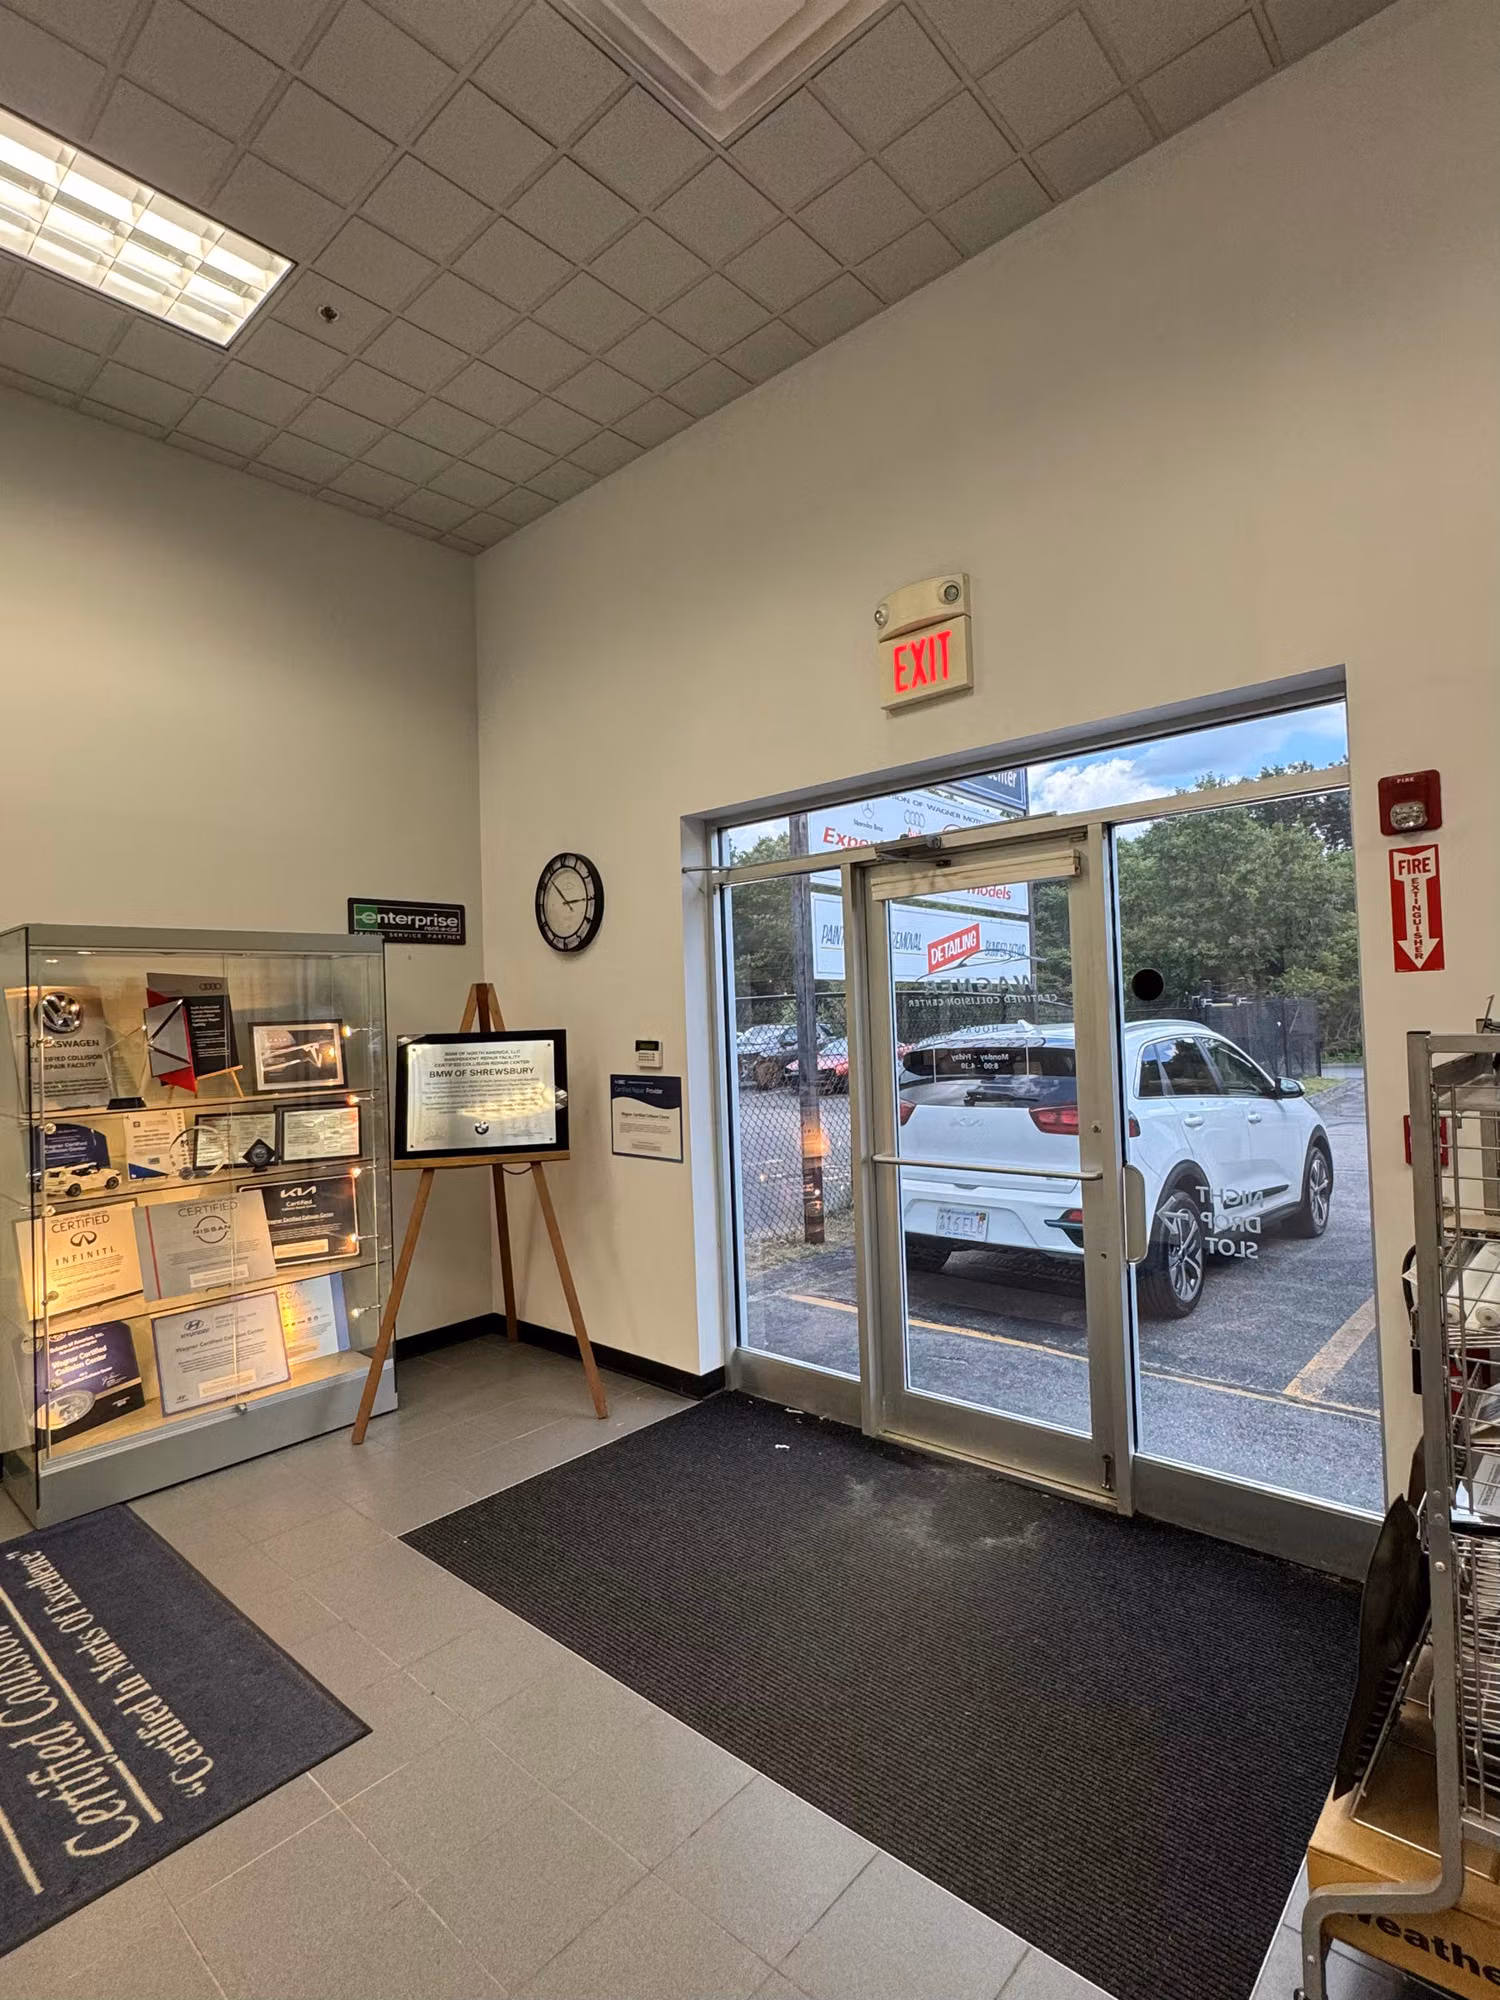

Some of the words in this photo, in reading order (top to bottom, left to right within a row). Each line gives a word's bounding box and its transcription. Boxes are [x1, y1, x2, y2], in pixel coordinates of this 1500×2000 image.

[893, 629, 952, 693] EXIT
[1396, 776, 1415, 784] FIRE
[912, 799, 924, 808] OF
[926, 803, 961, 818] WAGNER
[1398, 857, 1431, 876] FIRE
[359, 912, 459, 929] enterprise
[1411, 878, 1424, 959] EXTINGUISHER
[931, 930, 977, 965] DETAILING
[67, 1054, 103, 1062] COLLISION
[429, 1070, 454, 1078] BMW
[454, 1070, 468, 1078] OF
[469, 1066, 535, 1078] SHREWSBURY
[281, 1186, 316, 1198] KIA
[178, 1201, 238, 1217] CERTIFIED
[51, 1214, 110, 1234] CERTIFIED
[192, 1224, 231, 1235] NISSAN
[56, 1246, 116, 1266] INFINITI
[79, 1345, 108, 1359] Certified
[85, 1354, 107, 1366] Center
[51, 1607, 94, 1633] Of
[76, 1627, 134, 1684] Marks
[113, 1673, 152, 1706] In
[8, 1720, 140, 1857] Certified
[1347, 1913, 1500, 1987] eathe
